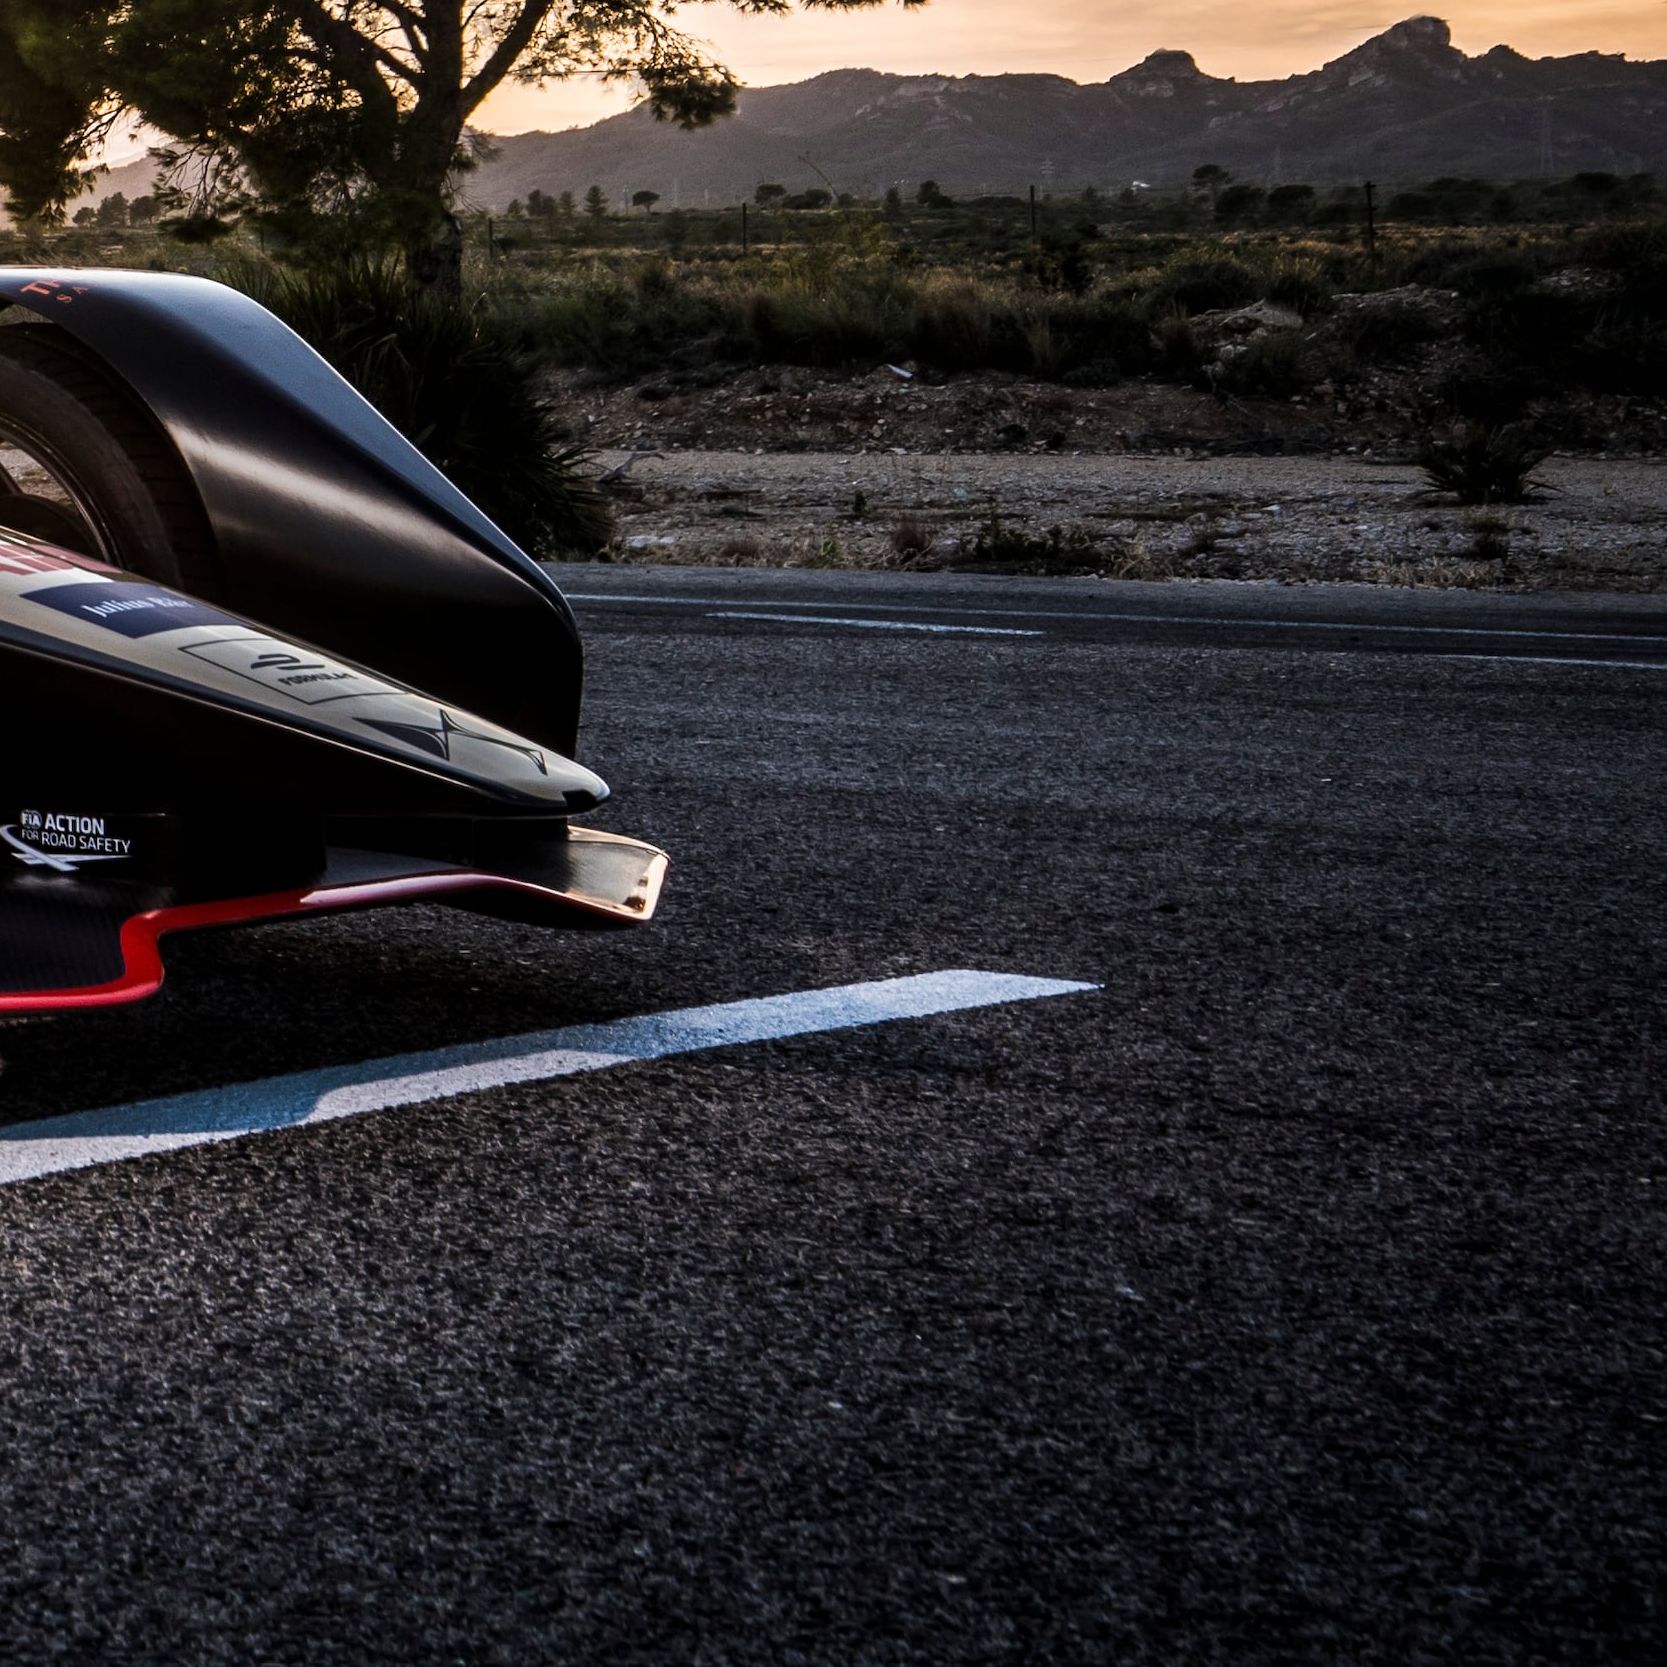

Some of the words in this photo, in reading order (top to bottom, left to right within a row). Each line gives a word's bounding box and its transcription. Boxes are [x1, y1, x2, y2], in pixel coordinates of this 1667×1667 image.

[21, 812, 41, 827] FIA
[45, 813, 105, 835] ACTION
[21, 830, 39, 841] FOR
[41, 831, 76, 848] ROAD
[79, 835, 131, 853] SAFETY
